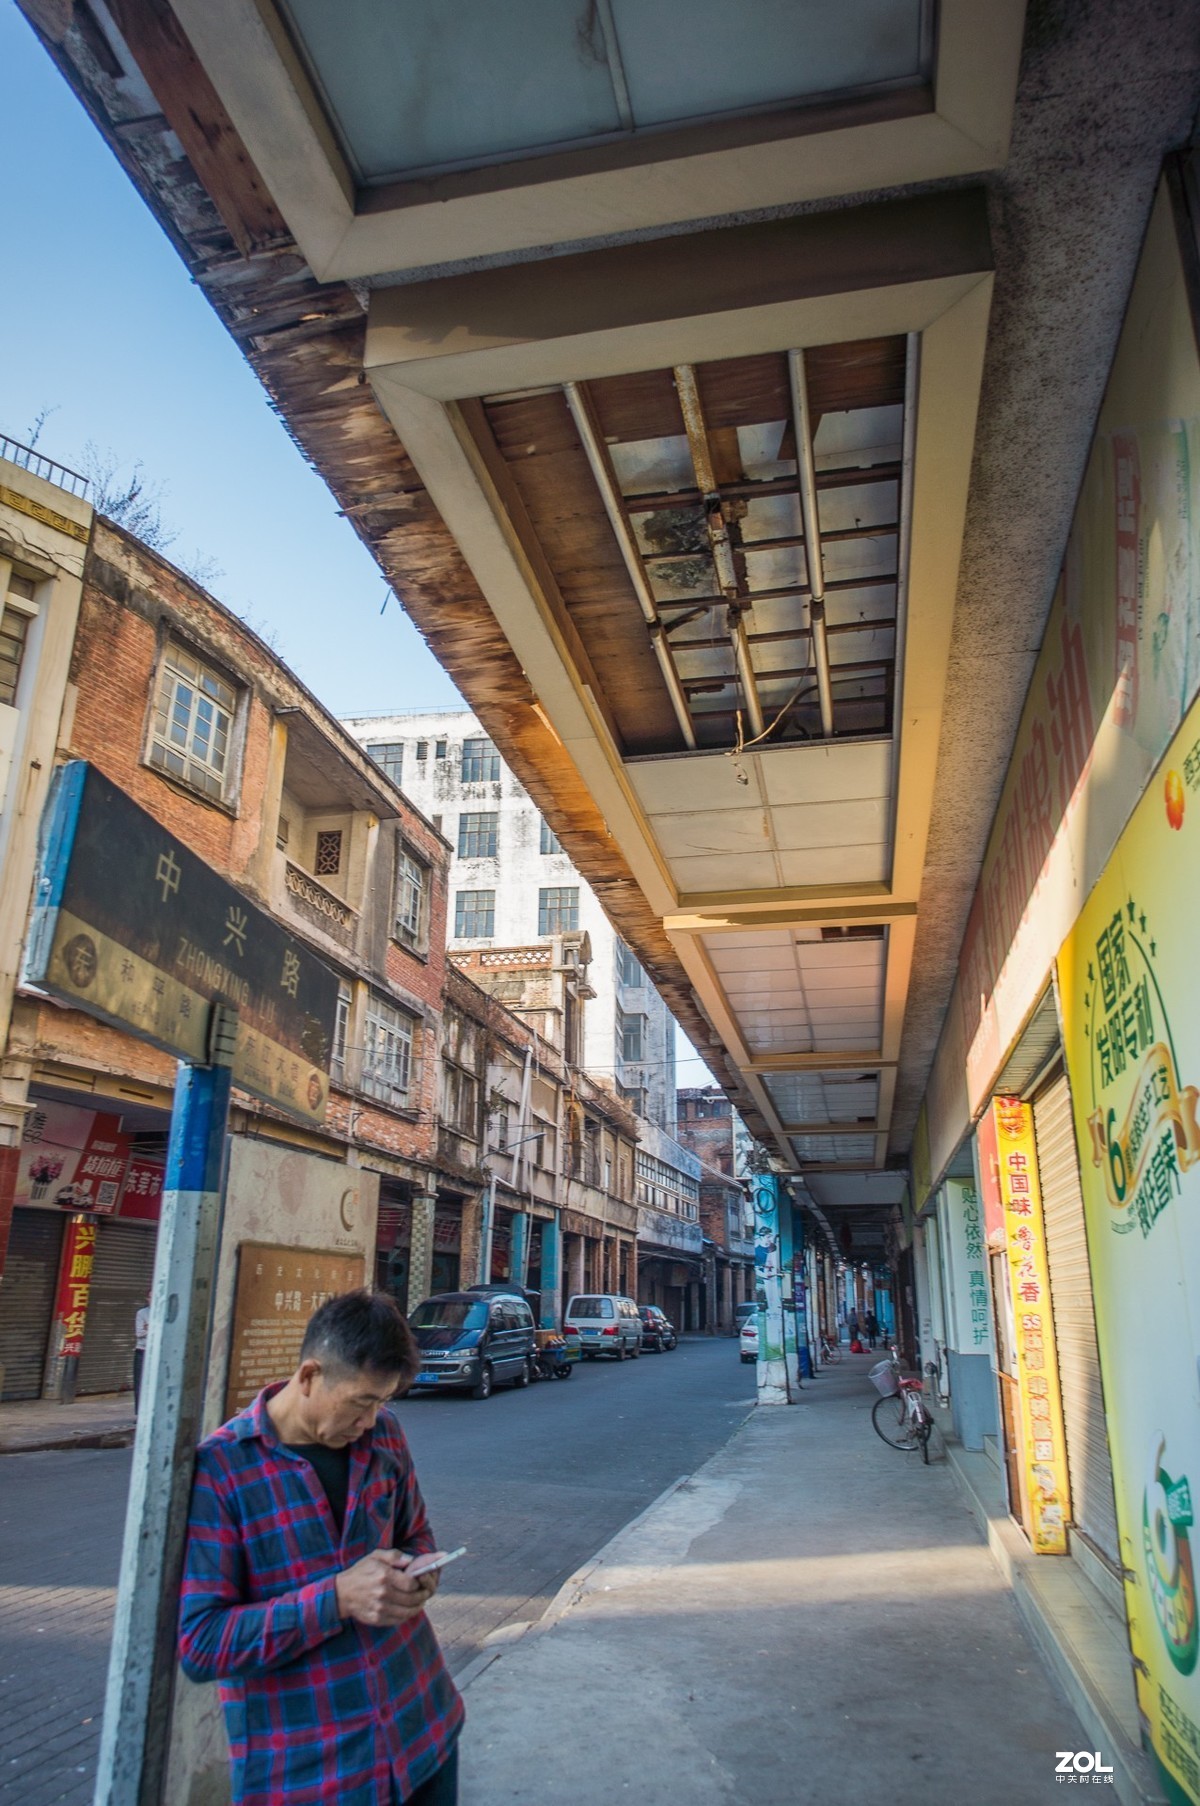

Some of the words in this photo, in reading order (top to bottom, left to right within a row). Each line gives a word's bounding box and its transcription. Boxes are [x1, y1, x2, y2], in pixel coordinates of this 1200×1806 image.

[156, 850, 301, 999] 中兴路
[1096, 908, 1131, 1014] 国家
[177, 937, 249, 1006] ZHONGXING
[259, 994, 276, 1023] LU
[1096, 974, 1154, 1089] 发明专利
[81, 1156, 126, 1177] 货拉拉
[1008, 1151, 1032, 1216] 中国味
[961, 1187, 984, 1259] 贴心依然
[1014, 1225, 1040, 1302] 鲁花香
[968, 1270, 989, 1345] 真情呵护
